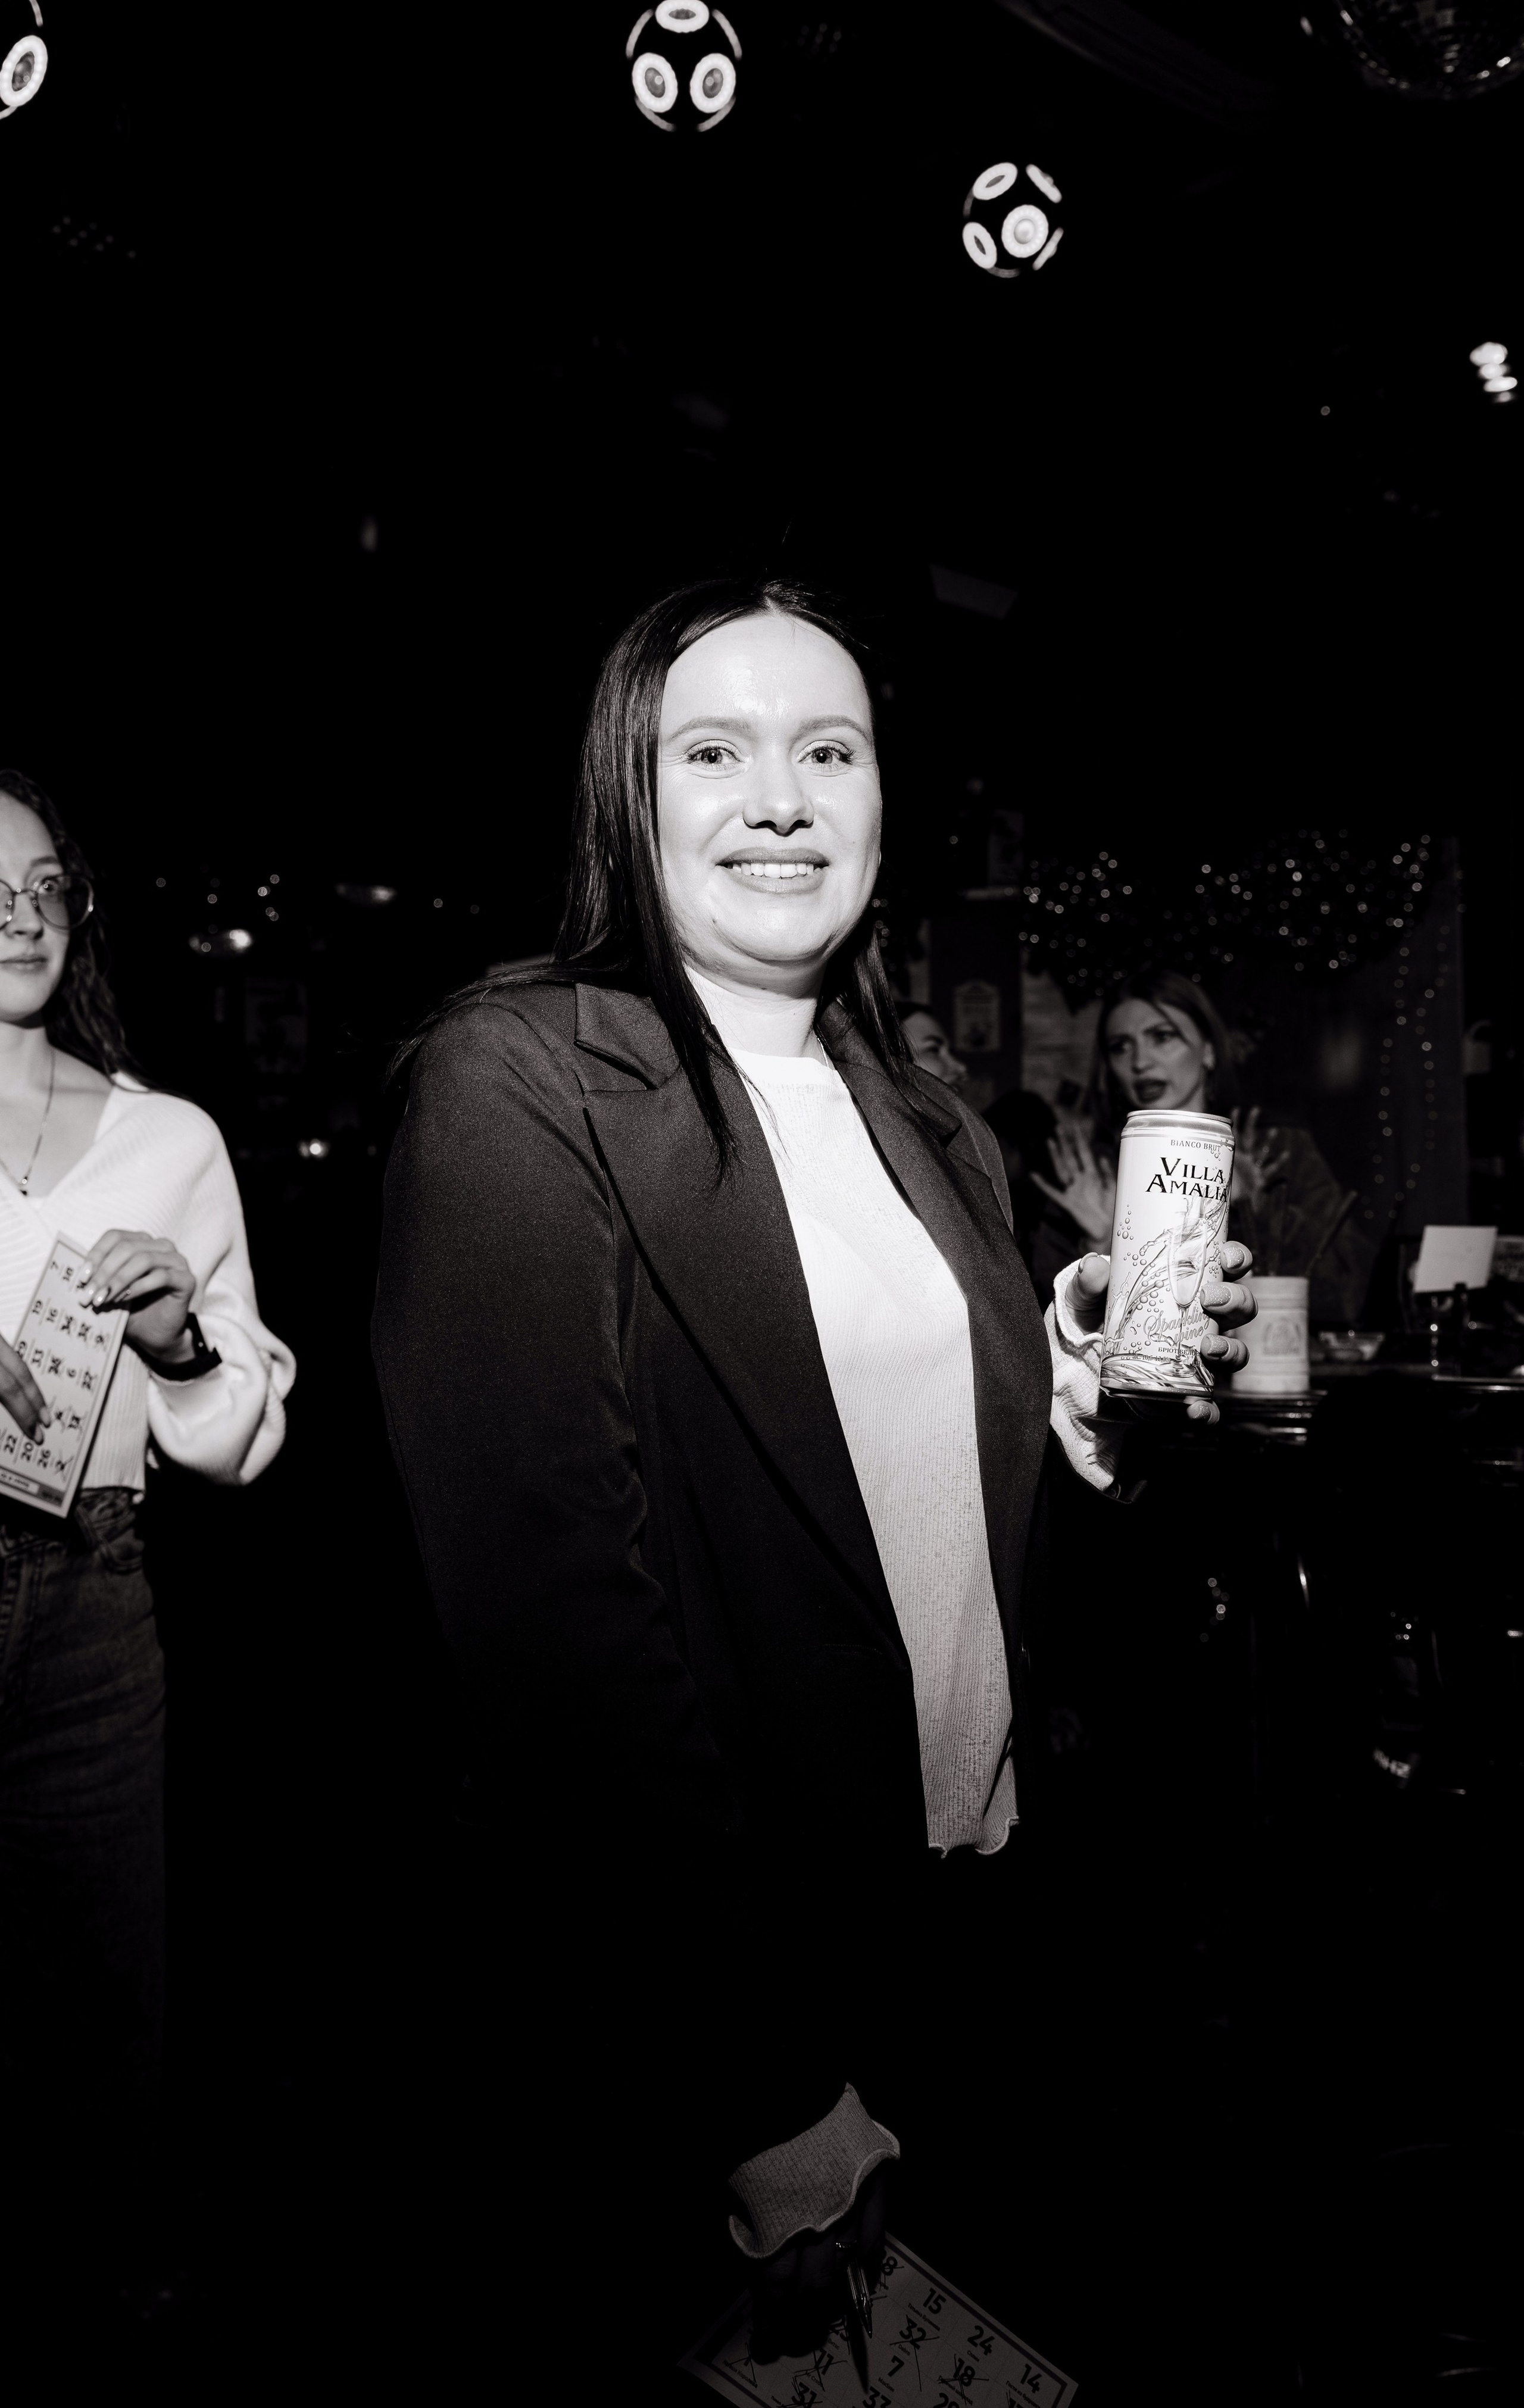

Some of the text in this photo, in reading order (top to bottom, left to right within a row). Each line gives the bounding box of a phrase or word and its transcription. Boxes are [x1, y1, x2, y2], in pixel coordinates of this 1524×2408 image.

[1170, 1139, 1221, 1152] BIANCO BRUT
[1160, 1157, 1224, 1184] VILLA
[1145, 1174, 1228, 1203] AMALIA
[1143, 1307, 1210, 1342] Sparkling
[1175, 1326, 1204, 1344] wine
[4, 1435, 18, 1455] 22
[21, 1441, 35, 1463] 20
[38, 1448, 52, 1469] 26
[923, 2288, 946, 2314] 15
[899, 2317, 926, 2350] 32
[967, 2325, 995, 2355] 24
[898, 2344, 910, 2356] Dabro
[888, 2355, 904, 2376] 7
[953, 2358, 976, 2387] 18
[1020, 2363, 1042, 2393] 14
